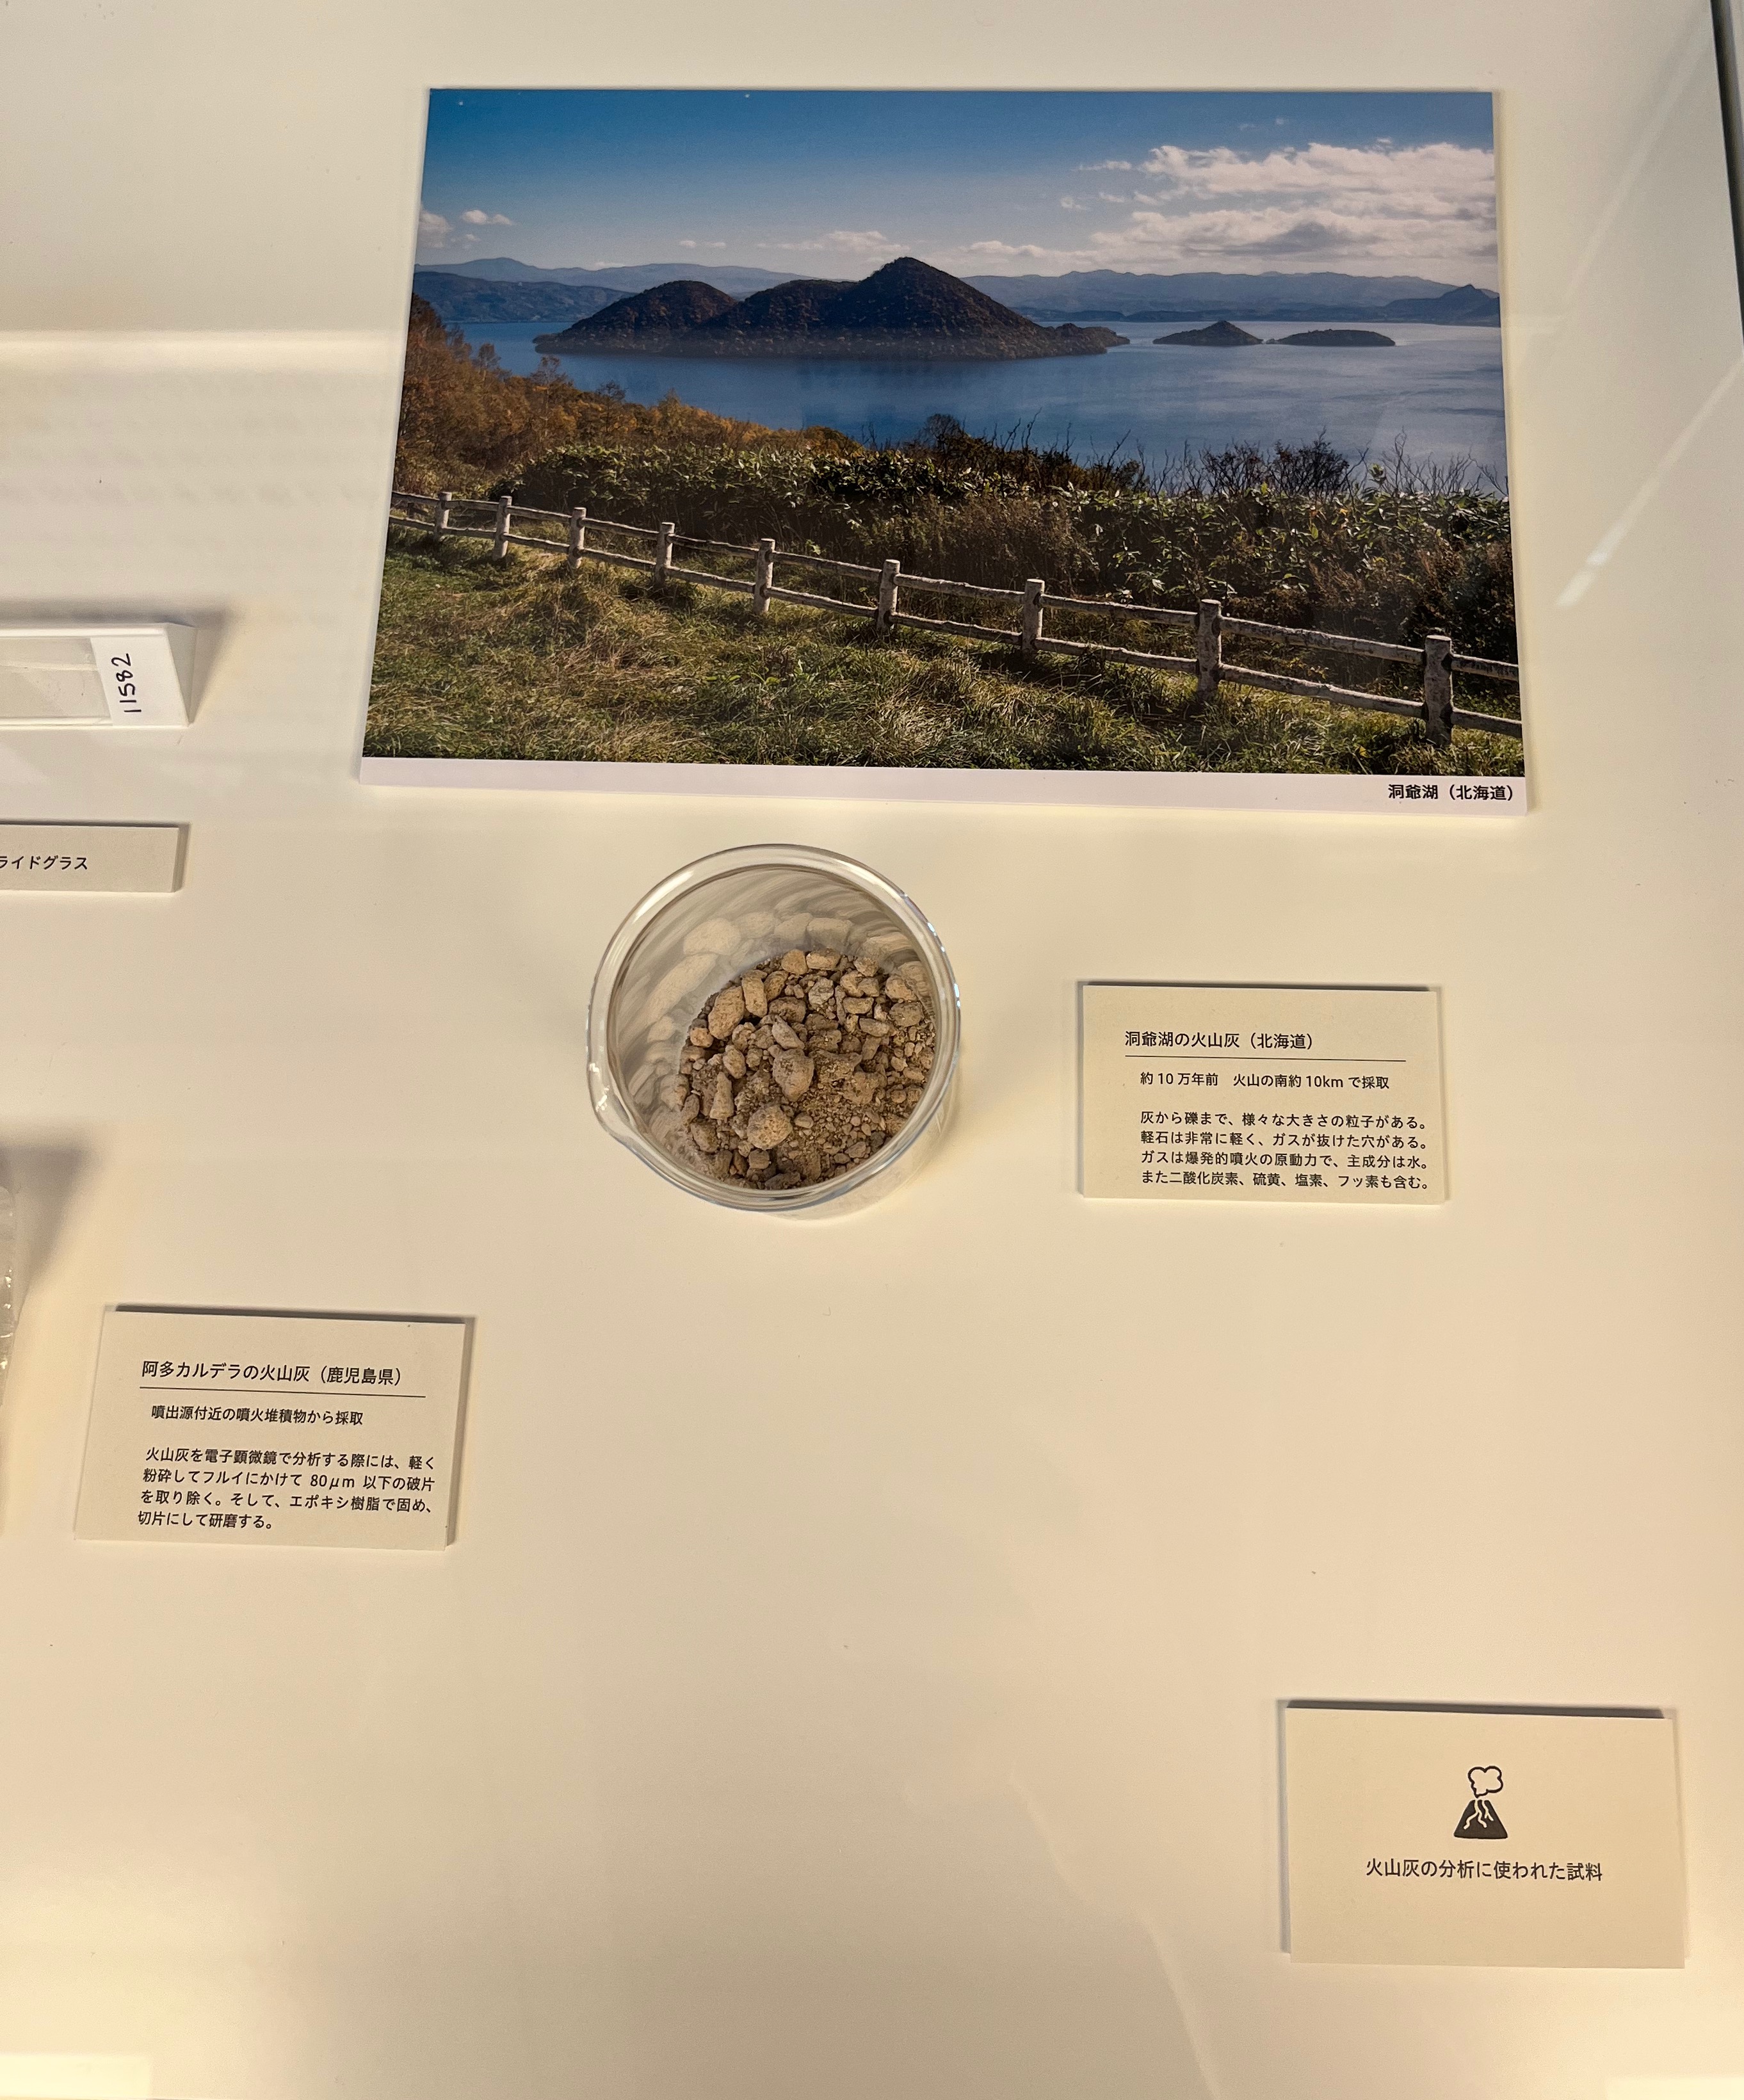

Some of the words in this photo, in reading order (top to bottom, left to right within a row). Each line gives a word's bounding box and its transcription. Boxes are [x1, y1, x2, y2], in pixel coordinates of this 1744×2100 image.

[111, 653, 141, 713] 11582
[1387, 784, 1513, 802] 洞爺湖（北海道）
[0, 855, 88, 870] ライドグラス
[1125, 1030, 1312, 1050] 洞爺湖の火山灰（北海道）
[1140, 1111, 1425, 1129] 灰から礫まで、様々な大きさの粒子がある。
[1140, 1130, 1426, 1149] 軽石は非常に軽く、ガスが抜けた穴がある。
[1141, 1150, 1427, 1169] ガスは爆発的噴火の原動力で、主成分は水。
[1142, 1170, 1428, 1190] また二酸化炭素、硫黄、塩素、フッ素も含む。
[140, 1361, 401, 1387] 阿多カルデラの火山灰（鹿児島県）
[150, 1405, 364, 1426] 噴出源付近の噴火堆積物から採取
[145, 1446, 435, 1470] 火山灰を電子顕微鏡で分析する際には、軽く
[140, 1489, 432, 1513] を取り除く。そして、エポキシ樹脂で固め、
[137, 1510, 273, 1530] 切片にして研磨する。
[1366, 1857, 1603, 1882] 火山灰の分析に使われた試料
